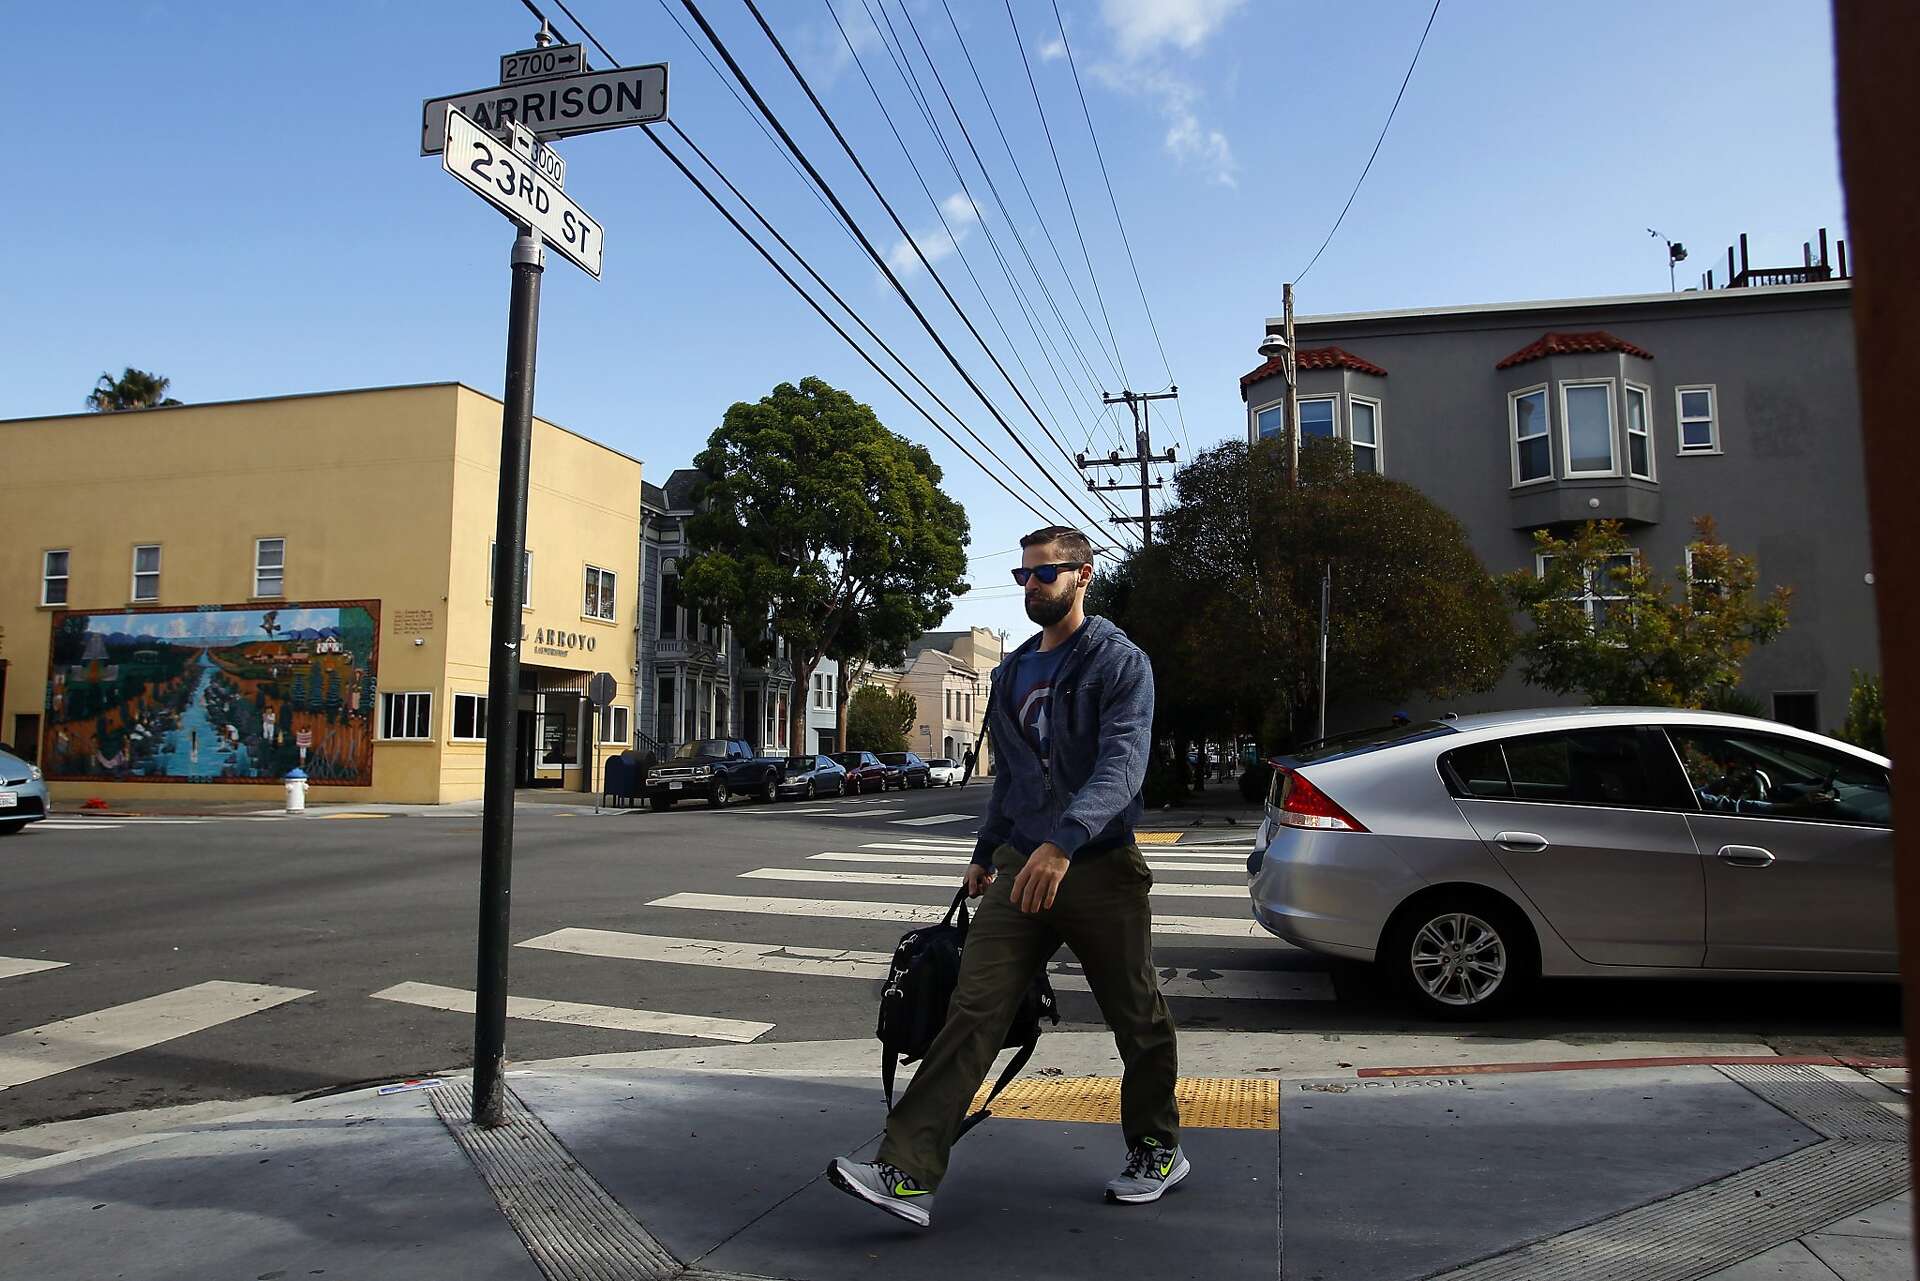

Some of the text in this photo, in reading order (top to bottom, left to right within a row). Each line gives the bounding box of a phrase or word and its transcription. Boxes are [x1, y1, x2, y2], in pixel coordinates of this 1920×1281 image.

[505, 54, 556, 79] 2700
[530, 146, 562, 182] 3000
[470, 141, 591, 254] 23RD ST
[534, 626, 597, 652] ARROYO
[1299, 1078, 1469, 1093] RRISON
